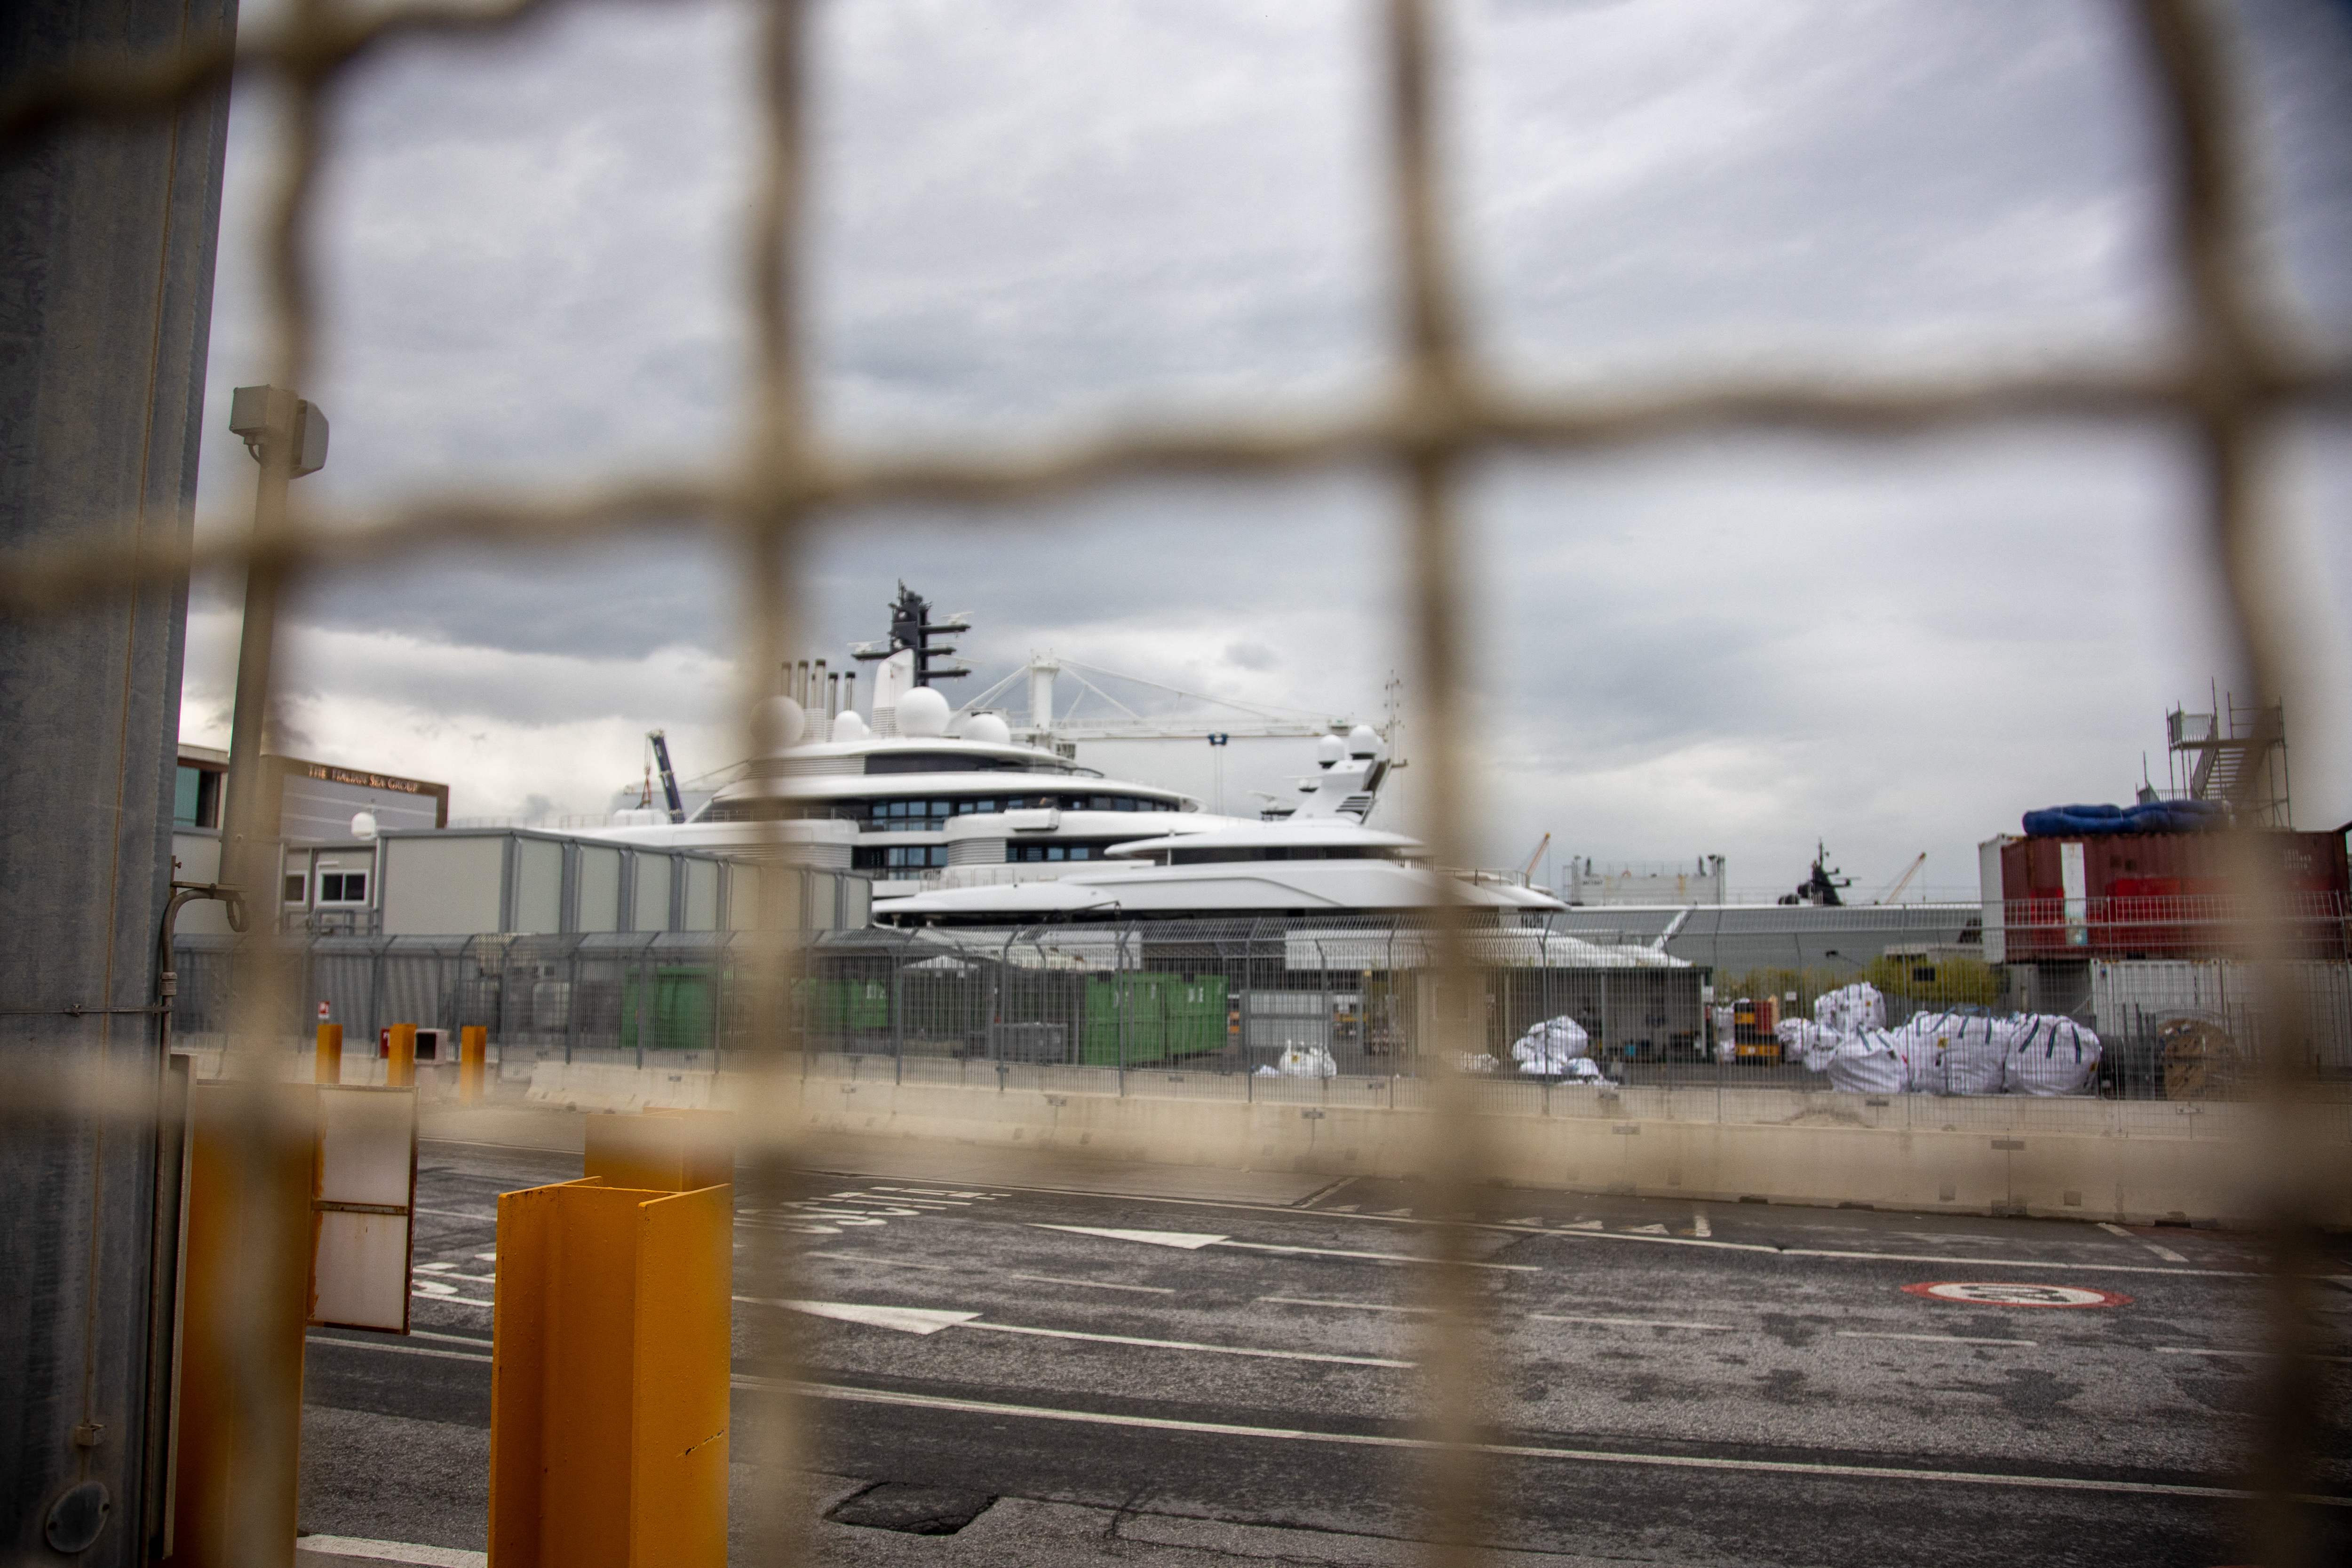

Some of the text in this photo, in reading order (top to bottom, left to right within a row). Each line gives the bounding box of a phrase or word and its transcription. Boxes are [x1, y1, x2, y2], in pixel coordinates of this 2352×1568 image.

[309, 764, 327, 780] THE
[369, 774, 384, 787] SEA
[388, 777, 418, 793] GROUP
